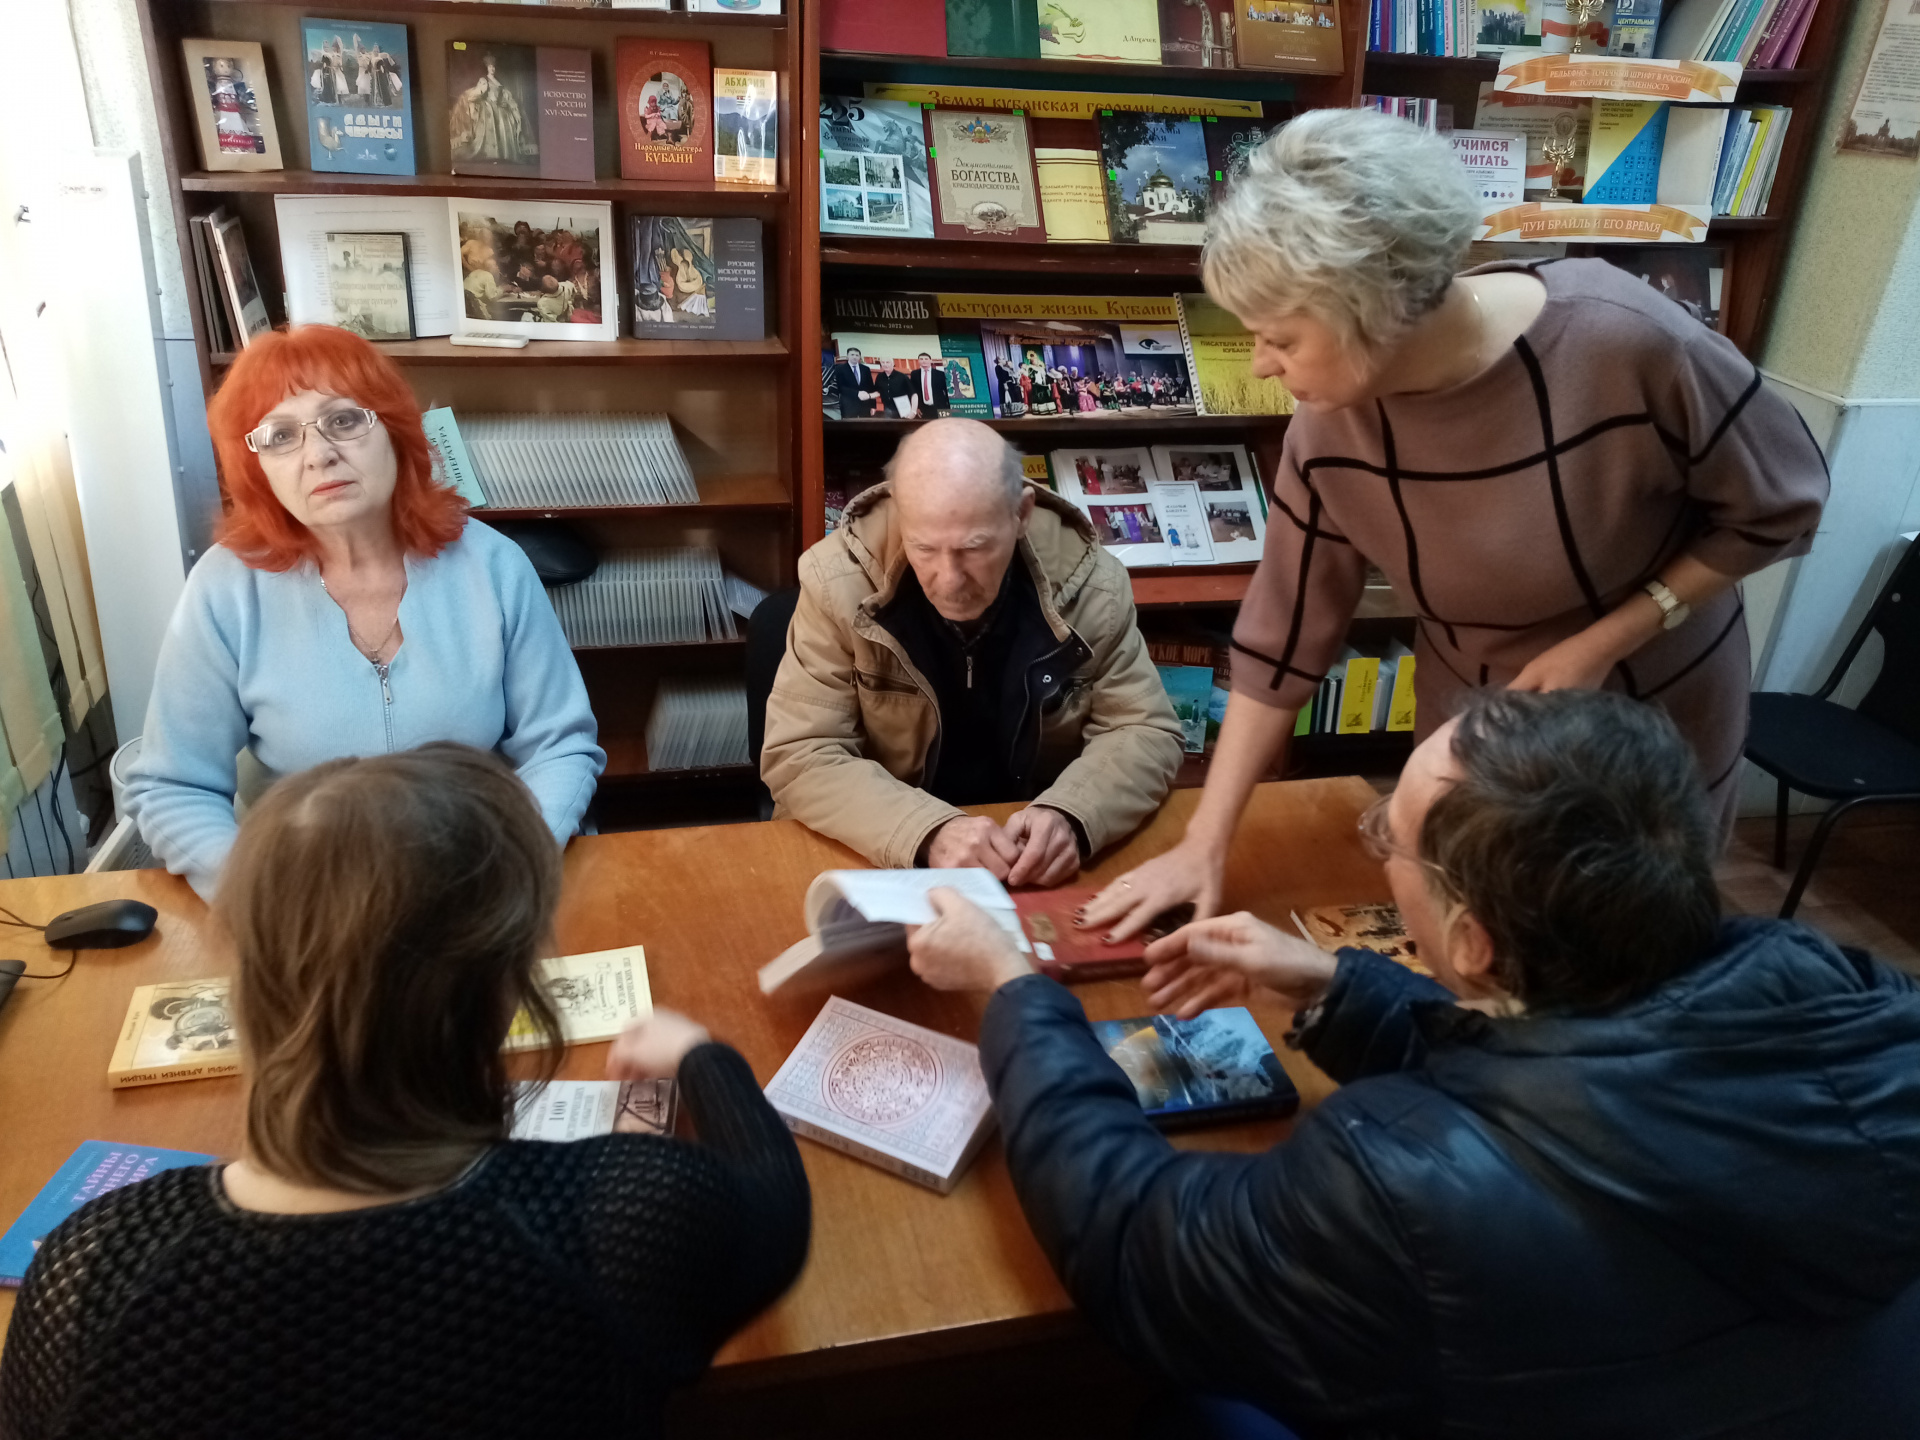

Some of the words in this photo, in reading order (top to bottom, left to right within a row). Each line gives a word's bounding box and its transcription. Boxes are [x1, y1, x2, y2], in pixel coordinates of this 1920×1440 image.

[724, 76, 766, 88] АБХАЗИЯ
[1569, 78, 1602, 87] ИСТОРИЯ
[1611, 80, 1670, 91] СОВРЕМЕННОСТЬ
[1630, 71, 1655, 81] ШРИФТ
[1662, 74, 1692, 84] РОССИИ
[544, 90, 586, 99] ИСКУССТВО
[928, 90, 986, 108] Земля
[344, 114, 402, 128] АДЫГИ
[344, 126, 403, 140] ЧЕРКЕСЫ
[634, 142, 671, 152] Народные
[673, 145, 703, 154] мастера
[1452, 139, 1509, 152] УЧИМСЯ
[645, 152, 693, 164] КУБАНИ
[1460, 154, 1509, 166] ЧИТАТЬ
[951, 169, 1019, 184] БОГАТСТВА
[1521, 220, 1545, 232] ЛУИ
[1548, 218, 1590, 230] БРАЙЛЬ
[1594, 218, 1600, 228] И
[1603, 220, 1624, 230] ЕГО
[1626, 220, 1662, 233] ВРЕМЯ
[834, 298, 878, 318] НАША
[881, 300, 929, 319] ЖИЗНЬ
[937, 300, 1034, 317] ультурная
[1041, 302, 1098, 316] жизнь
[1106, 300, 1172, 319] Кубани
[1183, 645, 1211, 664] МОРЕ
[120, 1074, 157, 1084] ГРЕЦИИ
[161, 1068, 203, 1078] ДРЕВНЕЙ
[548, 1101, 567, 1121] 100
[71, 1151, 124, 1202] ТАЙНЫ
[97, 1154, 139, 1196] ВНЕГО
